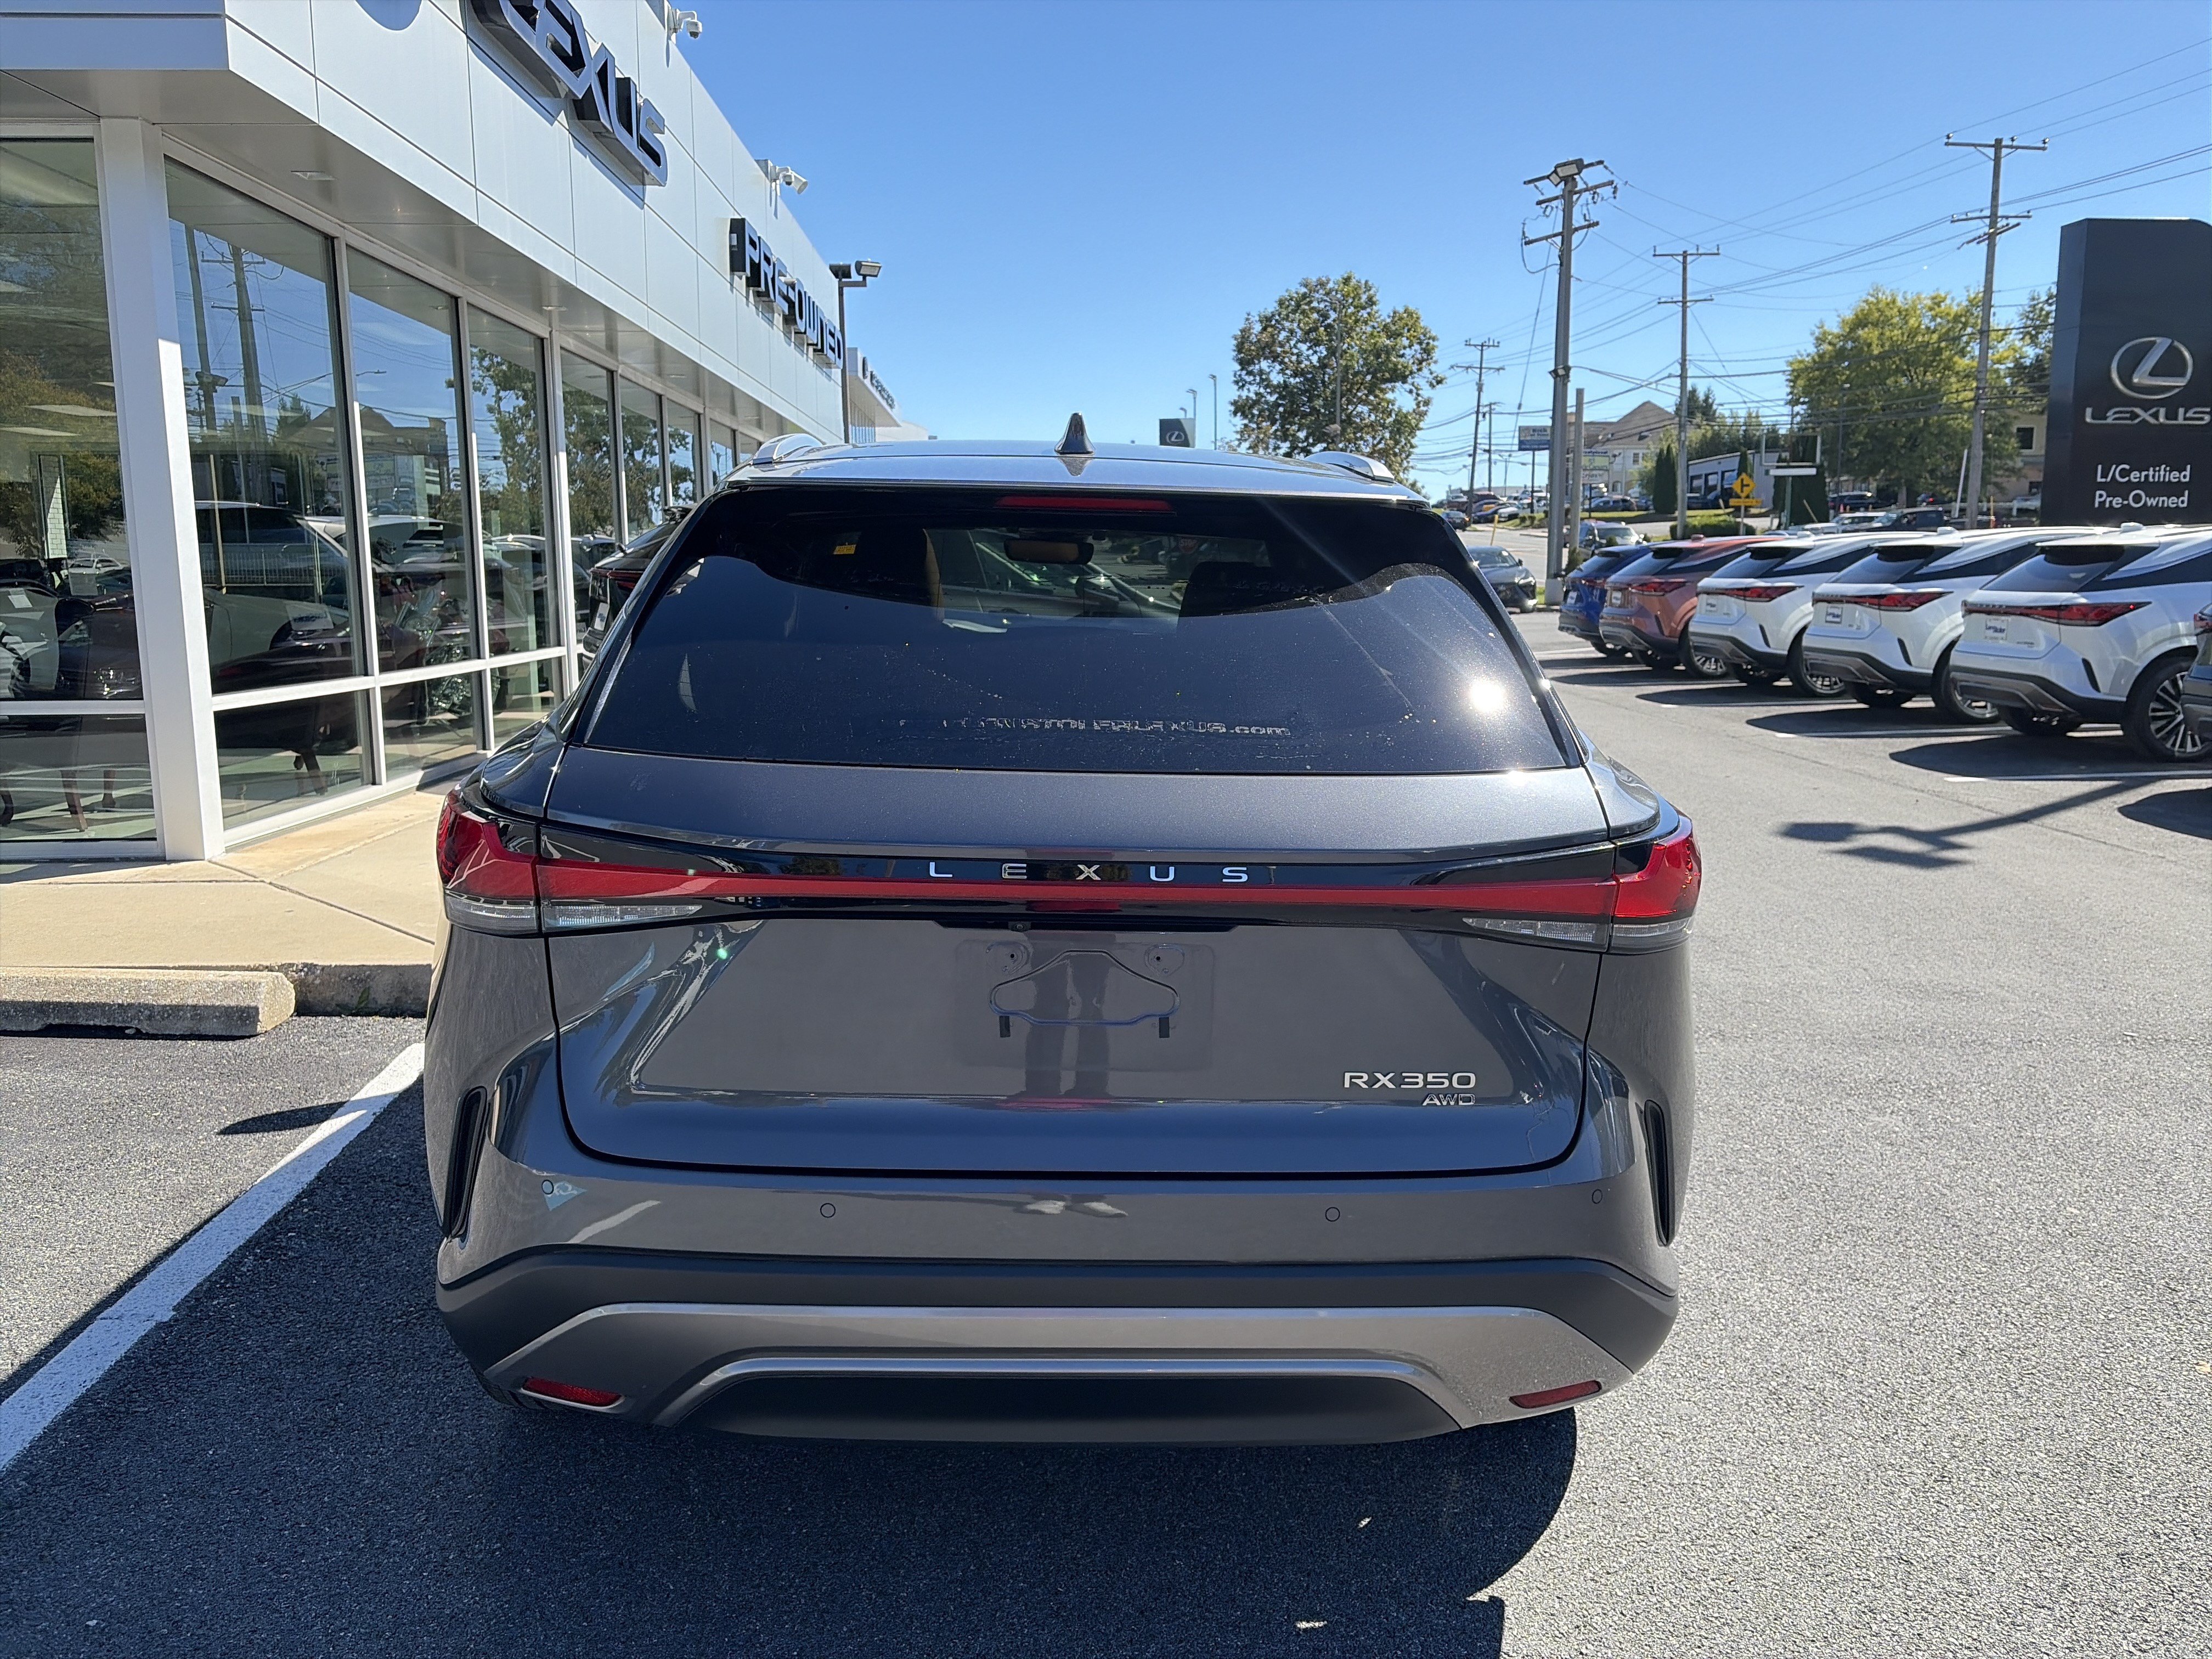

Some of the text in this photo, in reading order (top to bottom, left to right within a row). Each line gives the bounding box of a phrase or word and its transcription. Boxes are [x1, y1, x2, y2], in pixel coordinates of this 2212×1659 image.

[730, 218, 843, 369] PRE-OWNED
[2085, 407, 2211, 425] LEXUS
[2096, 464, 2191, 483] L/Certified
[2094, 489, 2188, 509] Pre-Owned
[929, 861, 1248, 883] LEXUS
[1344, 1071, 1476, 1090] RX350
[1422, 1093, 1476, 1106] AWD
